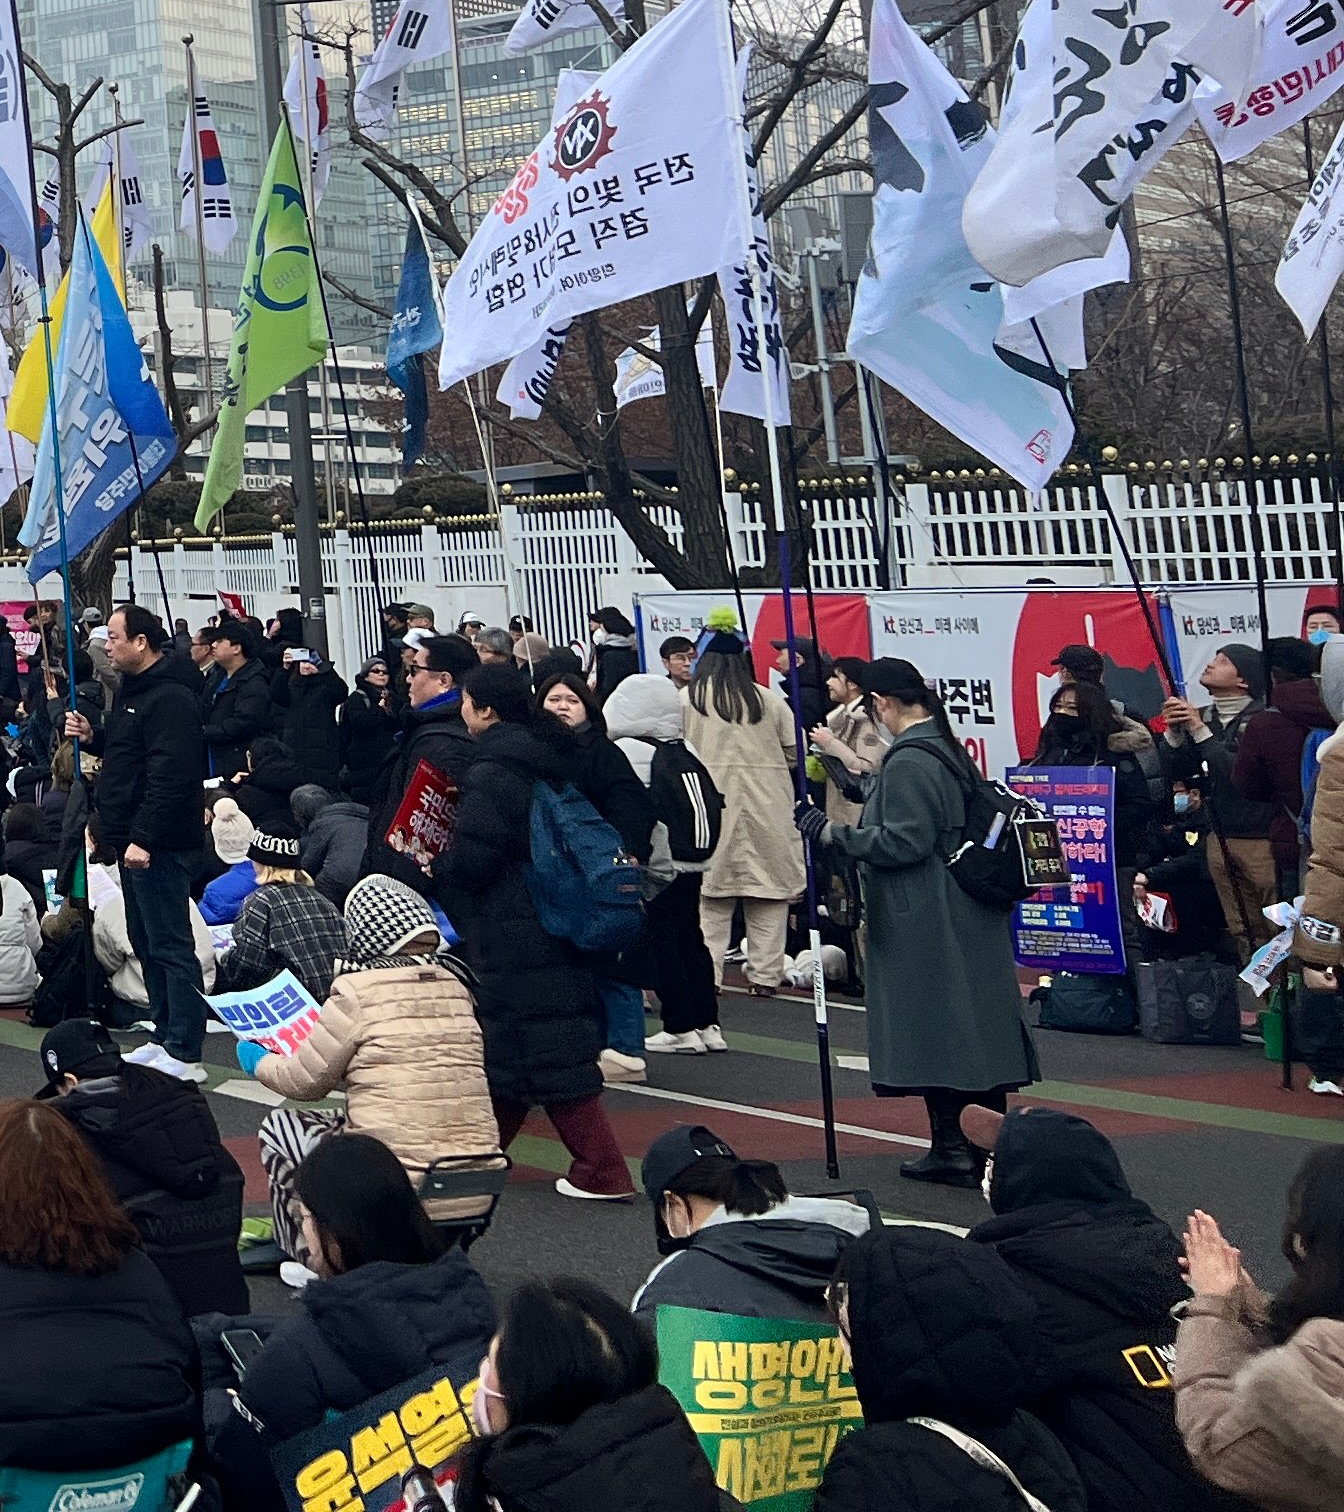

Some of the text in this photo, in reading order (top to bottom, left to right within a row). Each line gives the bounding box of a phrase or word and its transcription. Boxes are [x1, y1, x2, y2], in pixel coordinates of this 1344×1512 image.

[934, 678, 996, 726] 주변
[1056, 818, 1108, 840] 신공항
[295, 1376, 481, 1512] 윤석열
[58, 1486, 127, 1511] Coleman
